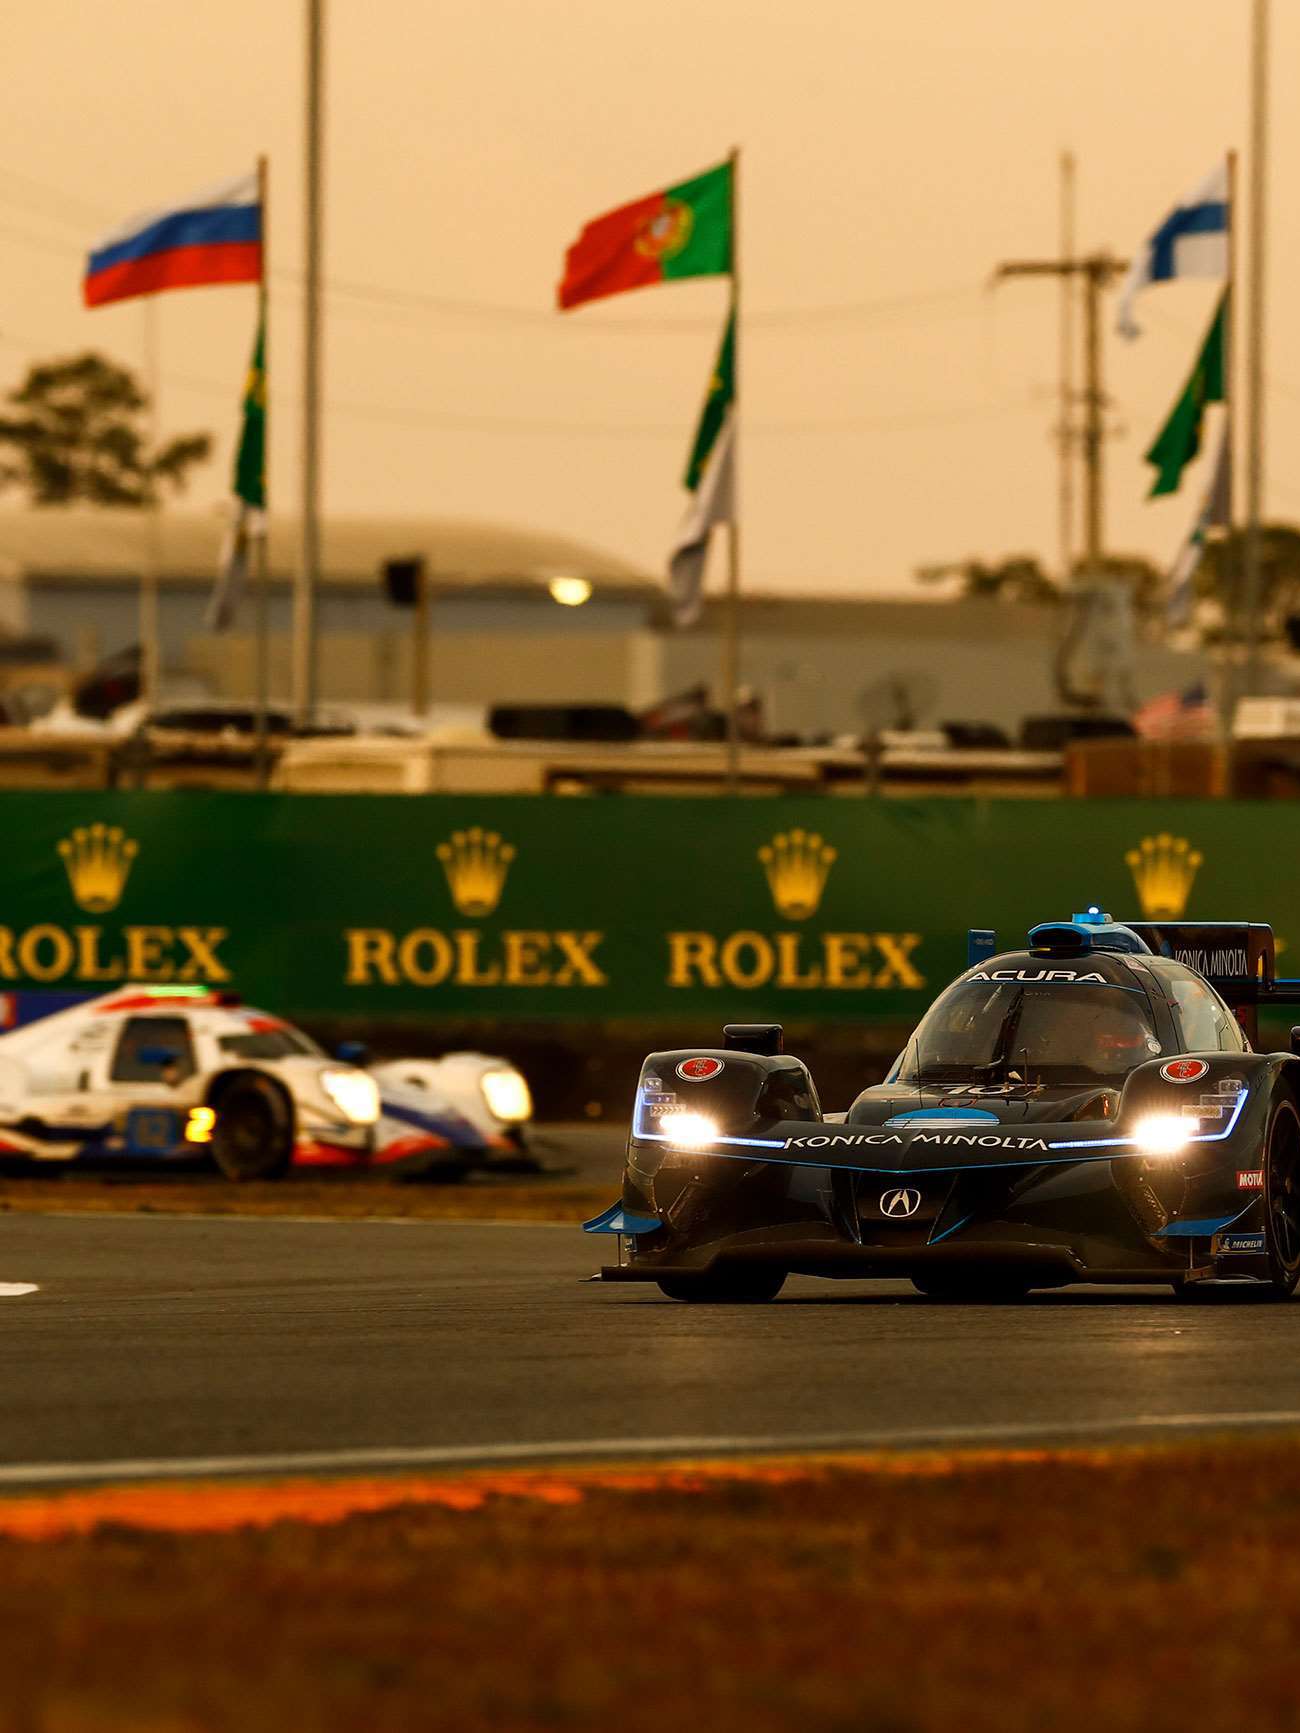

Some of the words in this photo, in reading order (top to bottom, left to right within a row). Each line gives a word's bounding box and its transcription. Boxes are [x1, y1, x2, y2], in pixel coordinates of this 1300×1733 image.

[344, 928, 607, 987] ROLEX
[666, 930, 925, 989] ROLEX
[1210, 948, 1248, 977] MINOLTA
[967, 970, 1108, 983] ACURA
[784, 1134, 903, 1149] KONICA
[911, 1133, 1049, 1151] MINOLTA
[1231, 1240, 1263, 1249] MICHELIN
